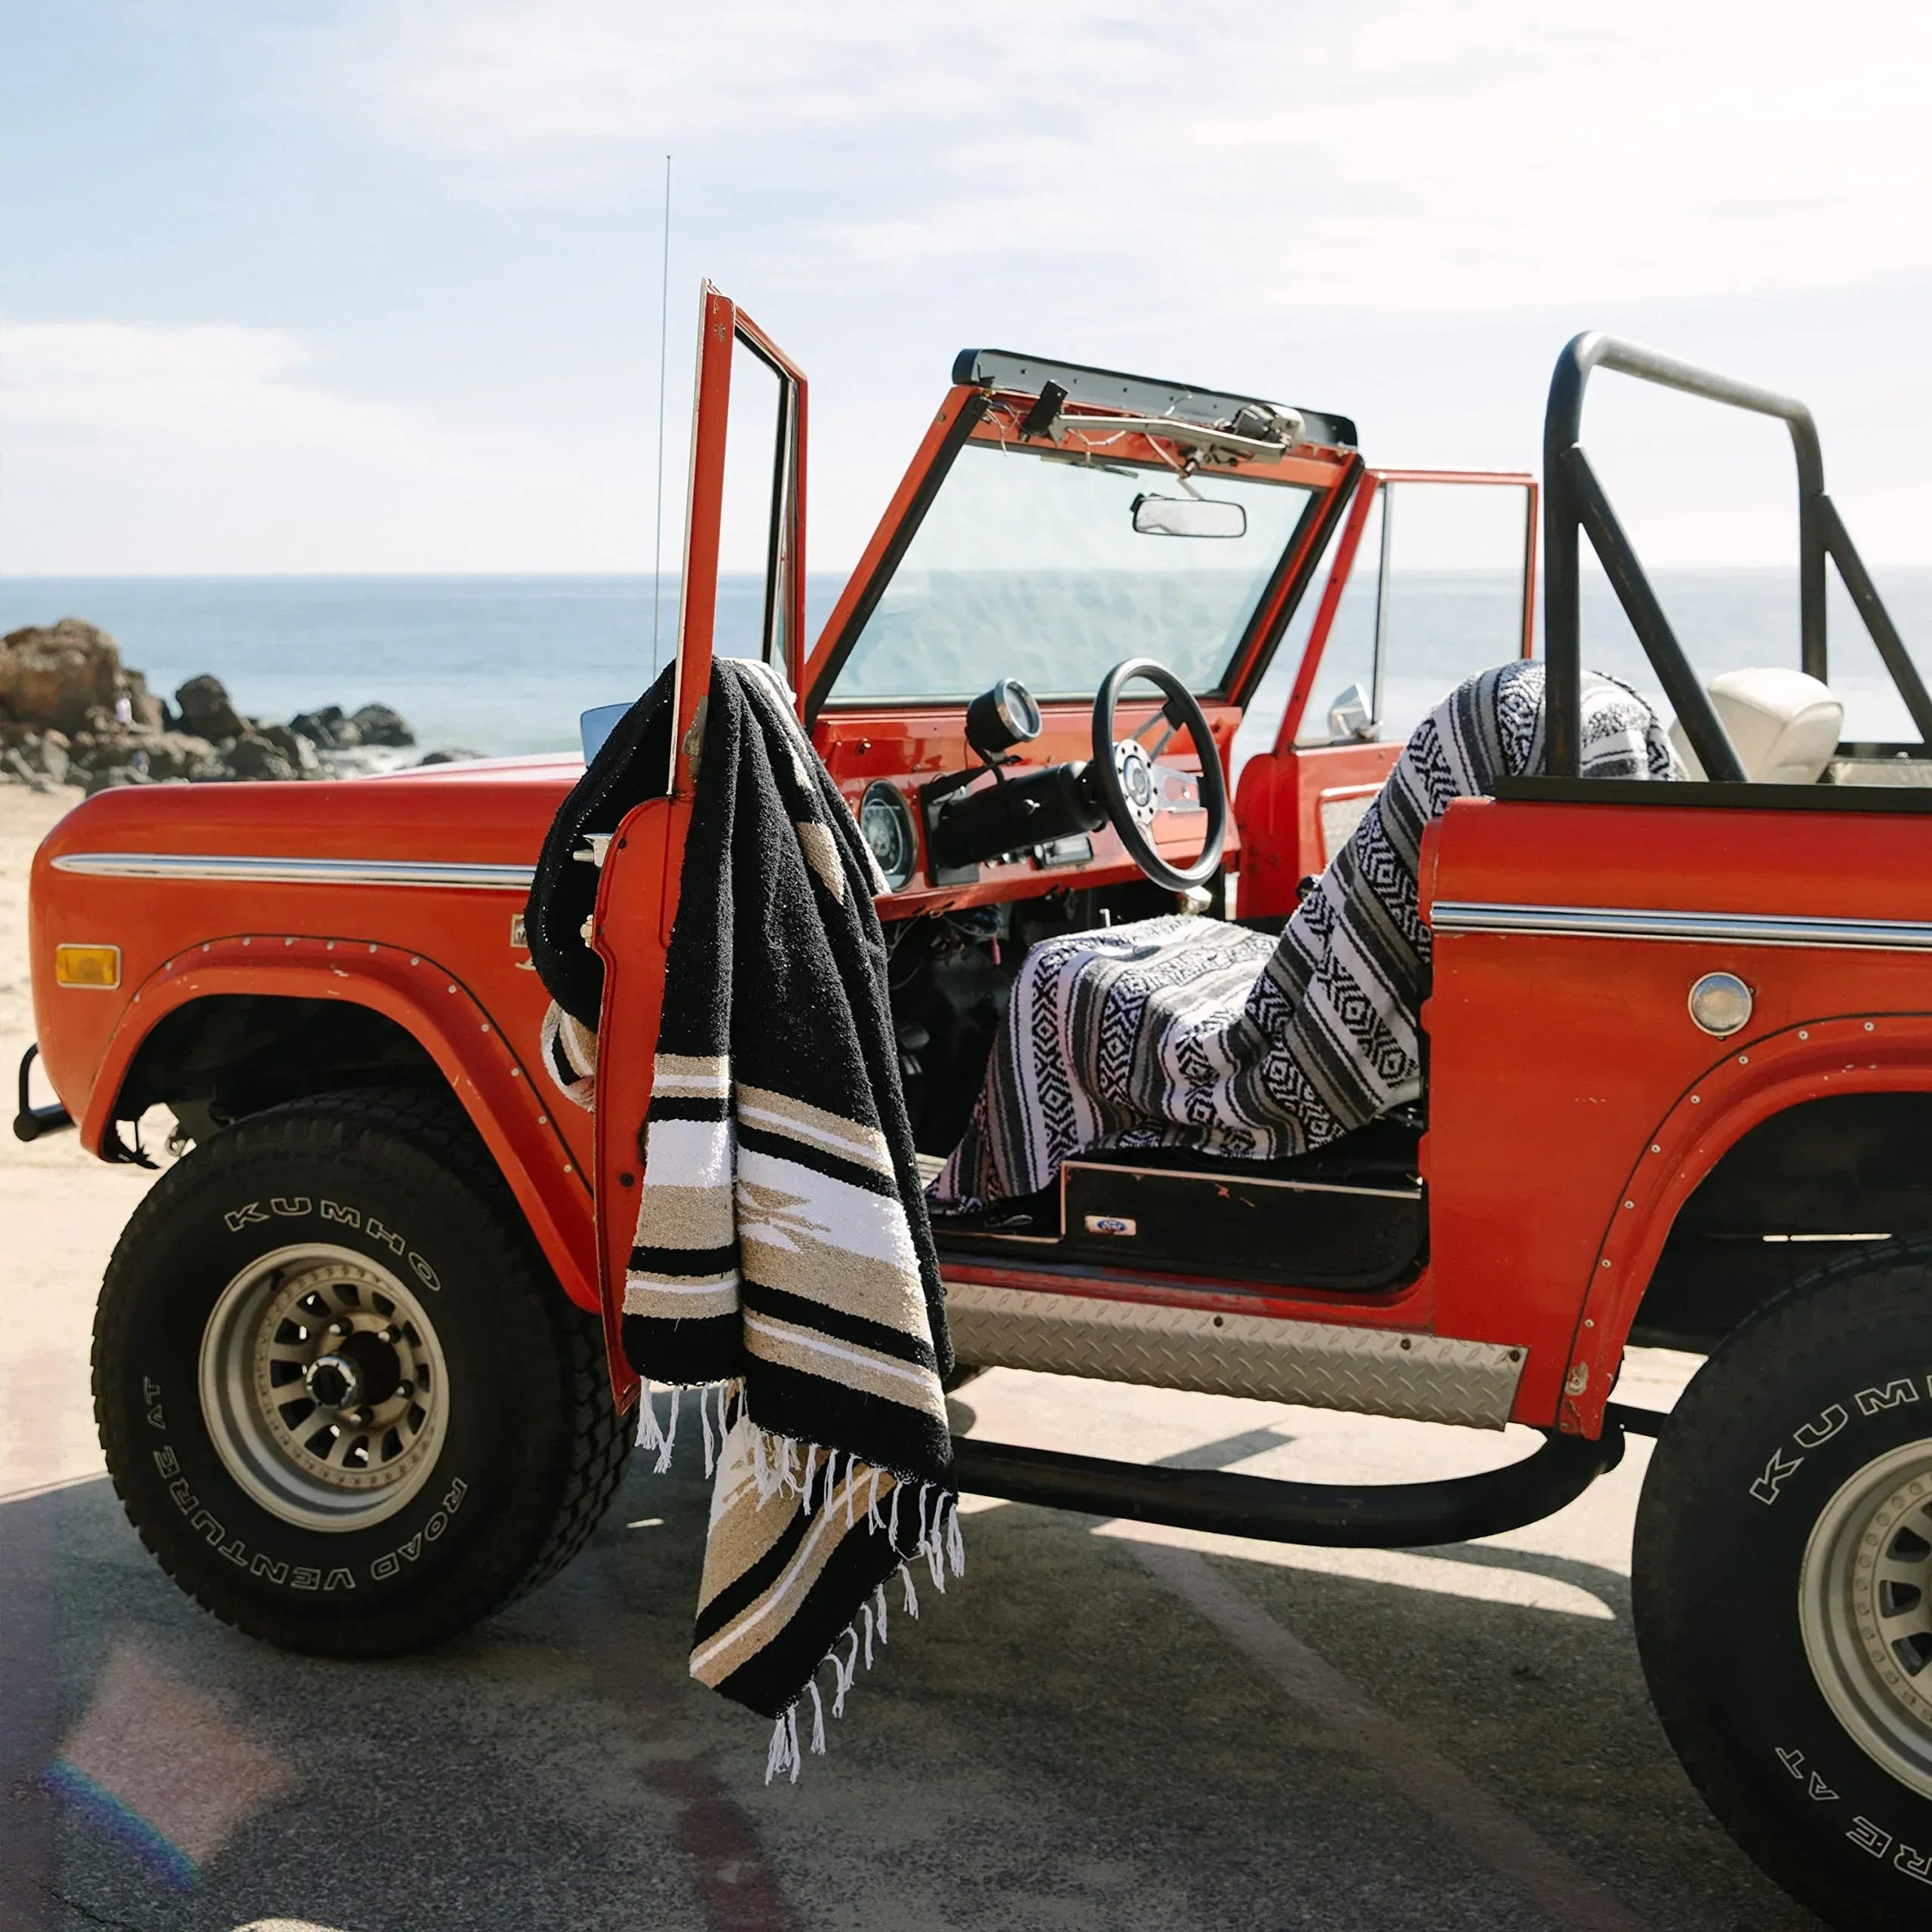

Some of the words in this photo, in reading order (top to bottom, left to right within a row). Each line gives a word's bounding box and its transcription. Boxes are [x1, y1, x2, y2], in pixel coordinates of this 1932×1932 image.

[223, 1196, 441, 1292] KUMHO
[143, 1376, 166, 1430] AT
[1749, 1375, 1932, 1506] KUM
[152, 1444, 356, 1591] VENTURE
[370, 1476, 469, 1581] ROAD
[1775, 1747, 1841, 1801] AT
